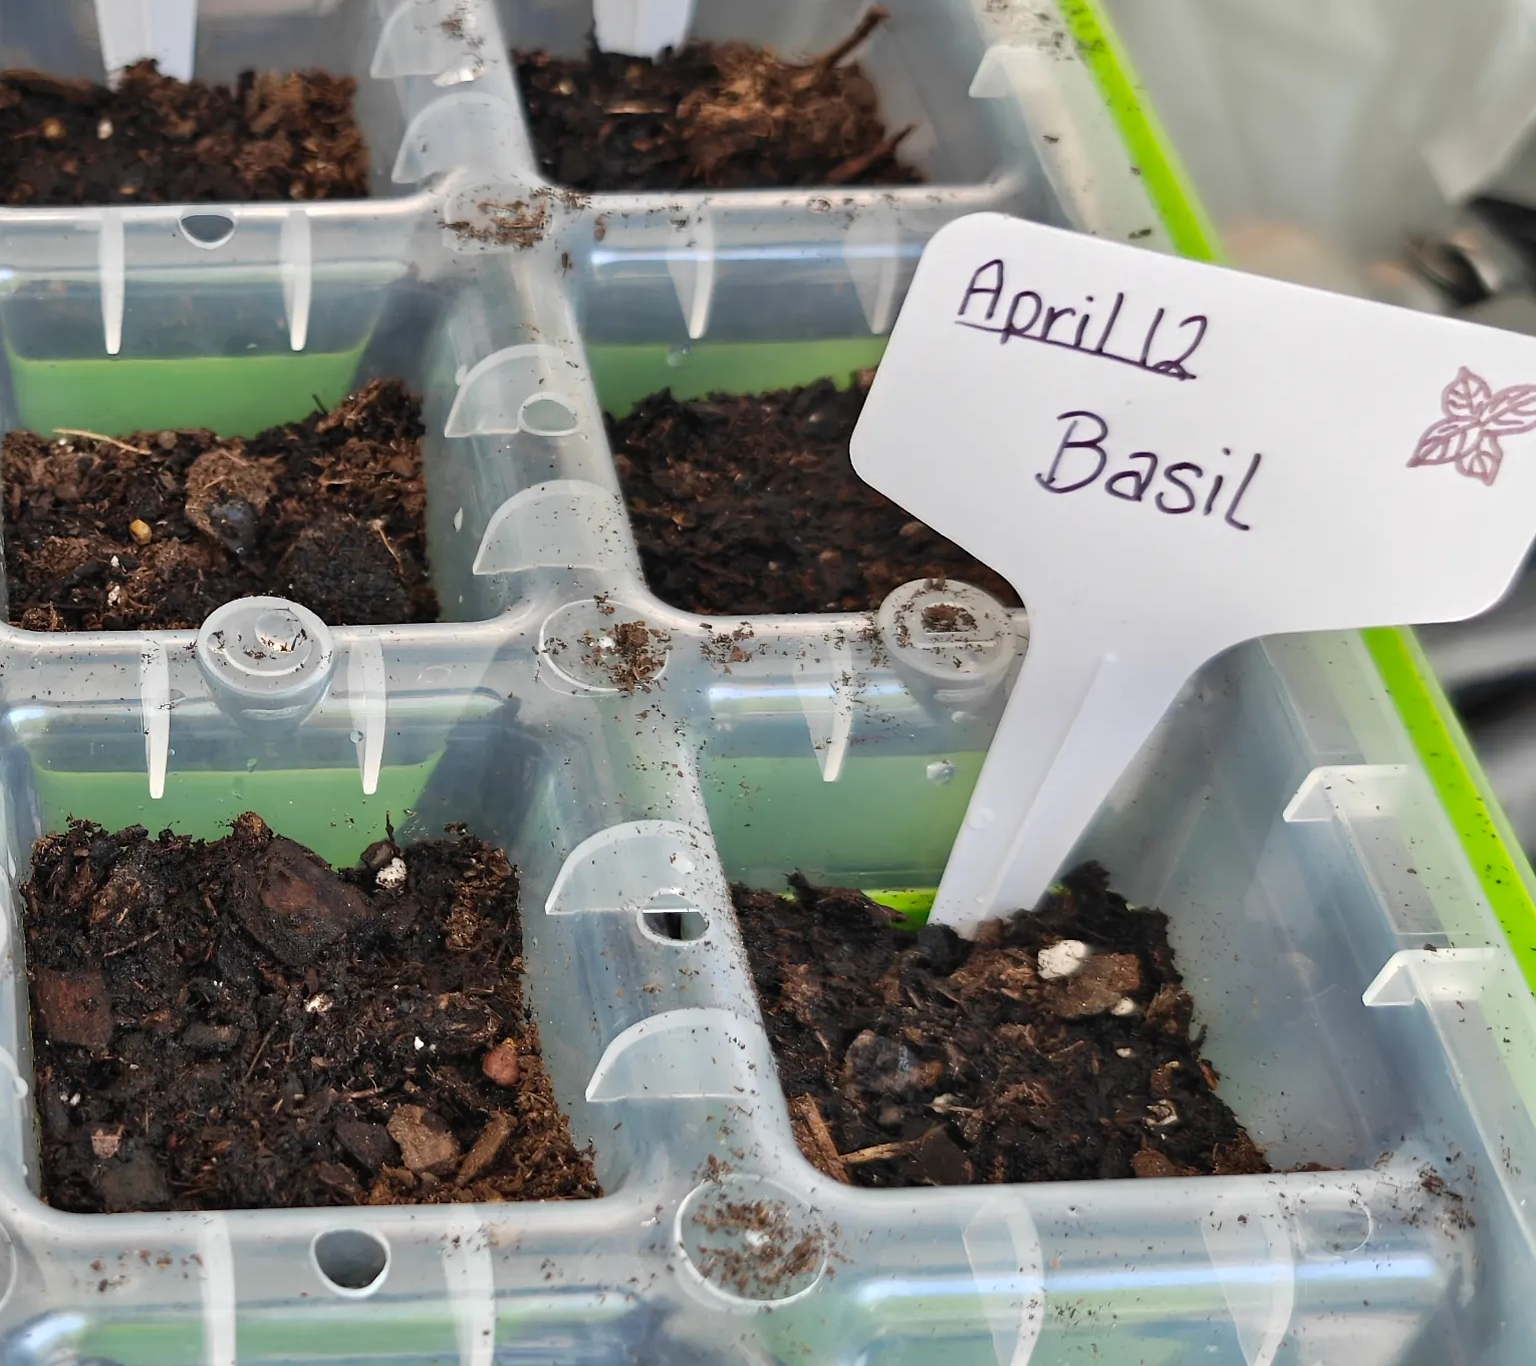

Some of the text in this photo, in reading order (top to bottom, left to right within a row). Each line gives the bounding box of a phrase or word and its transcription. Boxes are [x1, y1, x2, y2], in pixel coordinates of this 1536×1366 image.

[957, 258, 1209, 382] April 12
[1035, 410, 1262, 531] Basil
